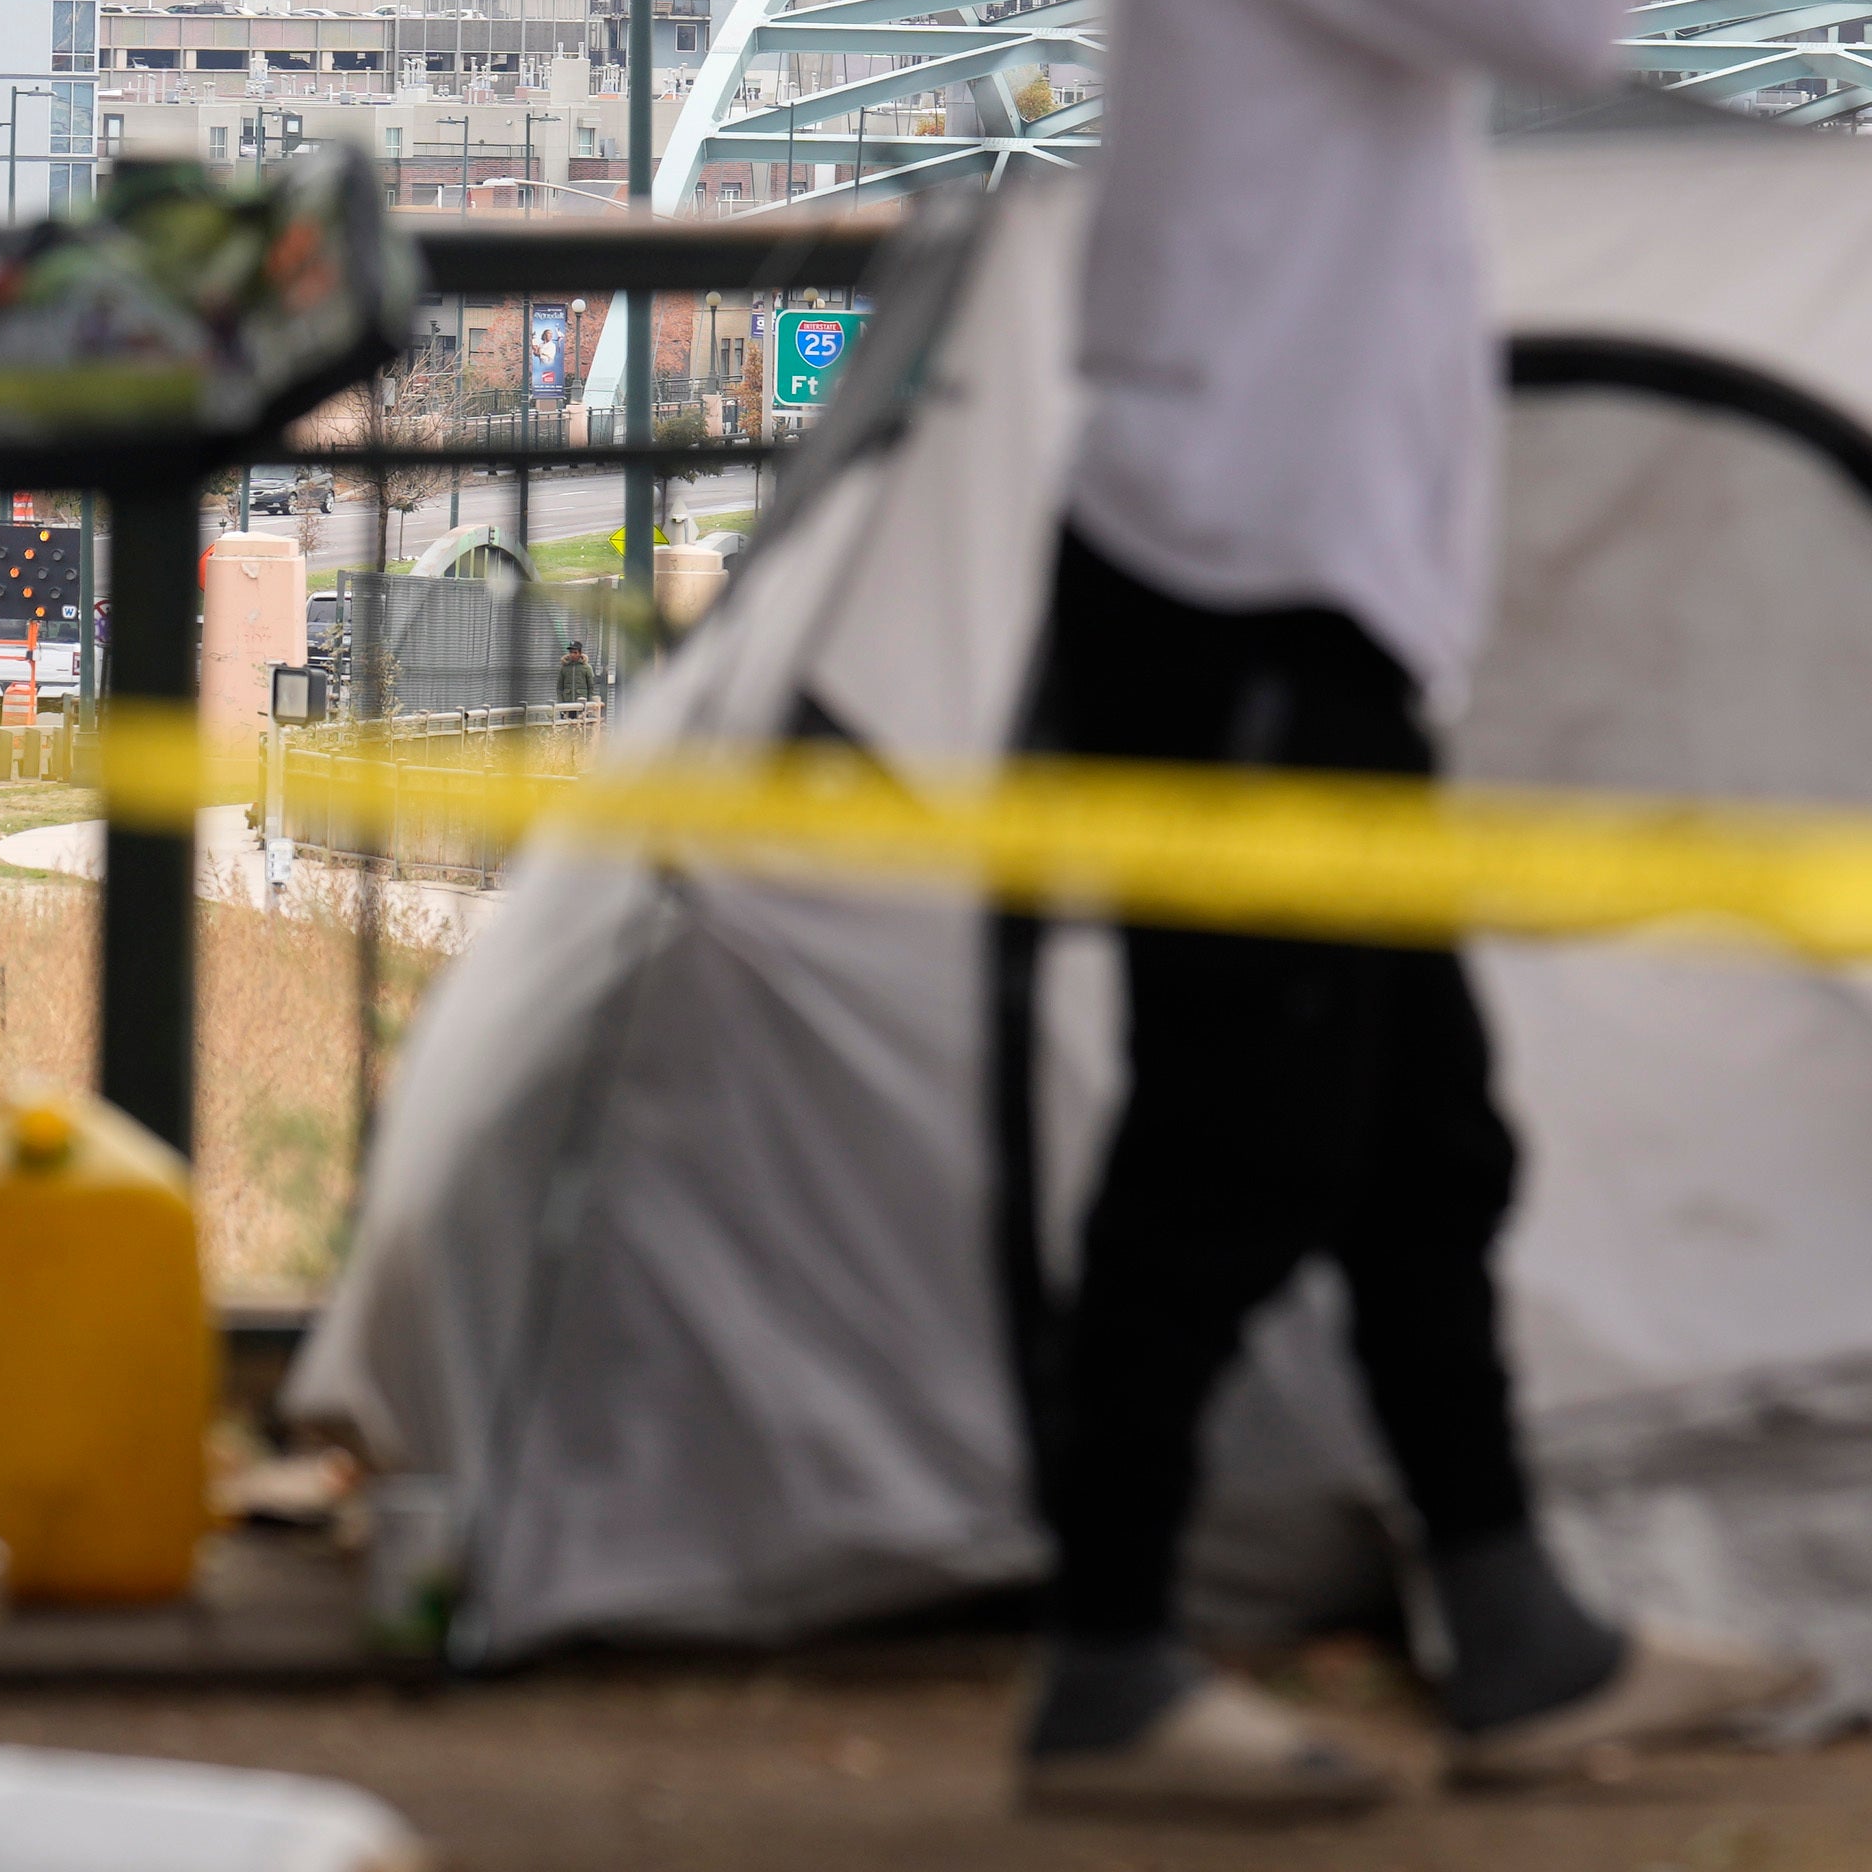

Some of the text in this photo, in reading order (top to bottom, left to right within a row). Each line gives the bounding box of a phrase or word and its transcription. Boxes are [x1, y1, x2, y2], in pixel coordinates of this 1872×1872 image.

[803, 323, 837, 331] INTERSTATE
[804, 333, 837, 357] 25
[791, 375, 819, 396] Ft
